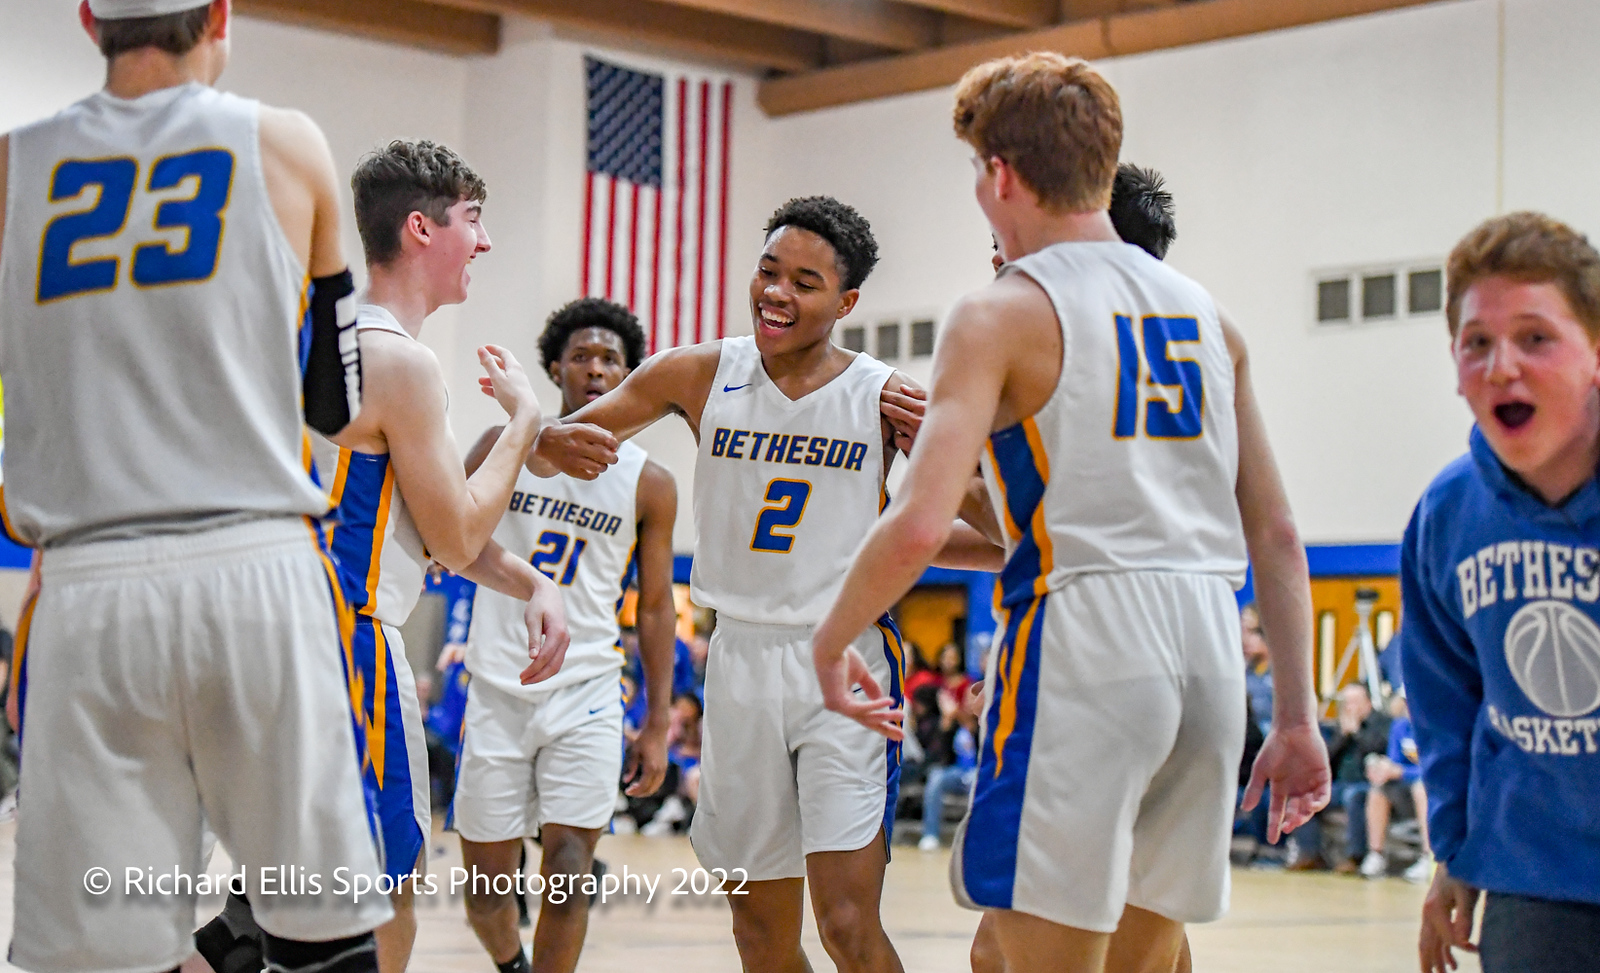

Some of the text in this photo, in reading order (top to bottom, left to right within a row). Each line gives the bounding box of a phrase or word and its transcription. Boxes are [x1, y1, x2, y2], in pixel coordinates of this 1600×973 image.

[36, 147, 236, 304] 23
[1112, 312, 1205, 441] 15
[711, 427, 868, 471] BETHESDA
[509, 491, 622, 536] BETHESDA
[750, 477, 812, 554] 2
[529, 529, 588, 587] 21
[1456, 540, 1600, 619] BETHES
[1487, 704, 1600, 755] SKET
